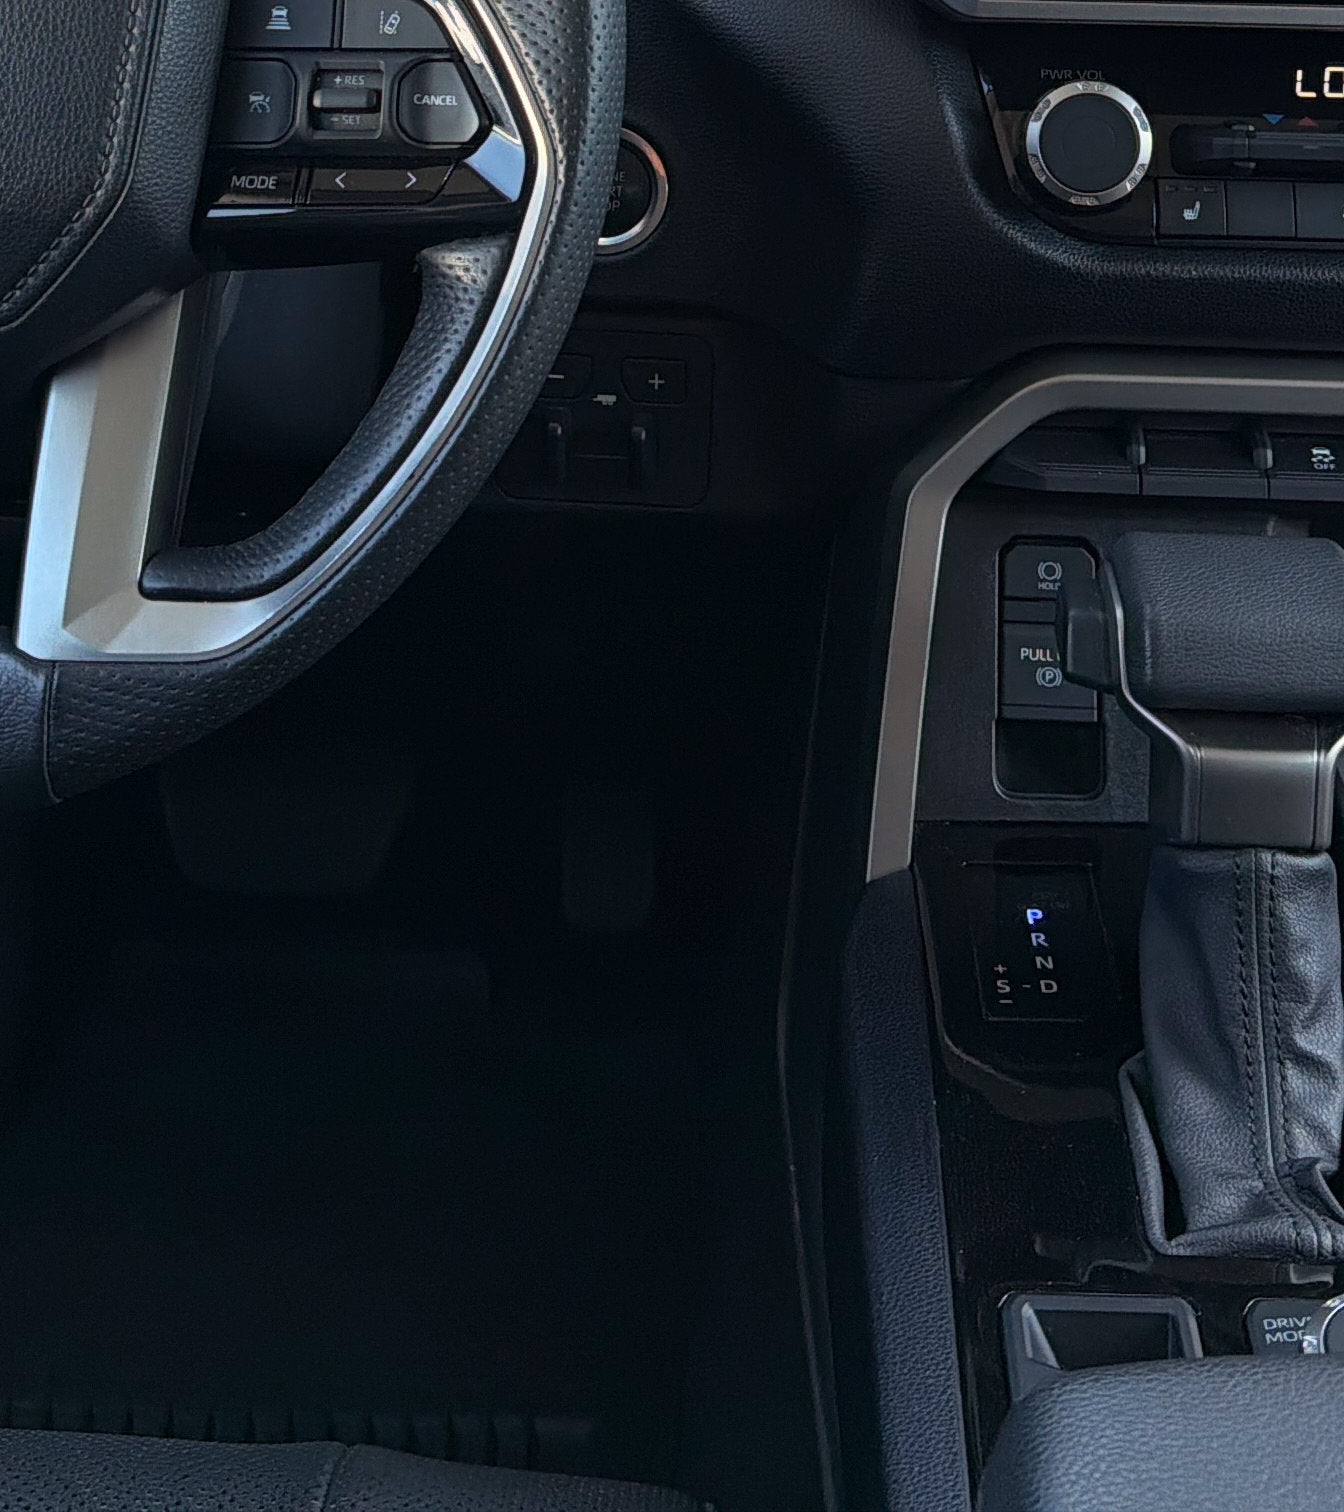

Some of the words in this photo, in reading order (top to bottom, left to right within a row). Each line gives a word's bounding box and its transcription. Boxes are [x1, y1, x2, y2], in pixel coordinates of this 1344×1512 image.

[1041, 69, 1072, 79] PWR
[1077, 70, 1105, 80] VOL
[414, 93, 457, 106] CANCEL
[231, 175, 277, 189] MODE
[1021, 648, 1054, 661] PULL
[1027, 909, 1043, 924] P
[1031, 933, 1048, 947] R
[1036, 956, 1053, 969] N
[997, 980, 1011, 994] S
[1040, 980, 1058, 994] D
[1263, 1317, 1311, 1330] DRIV
